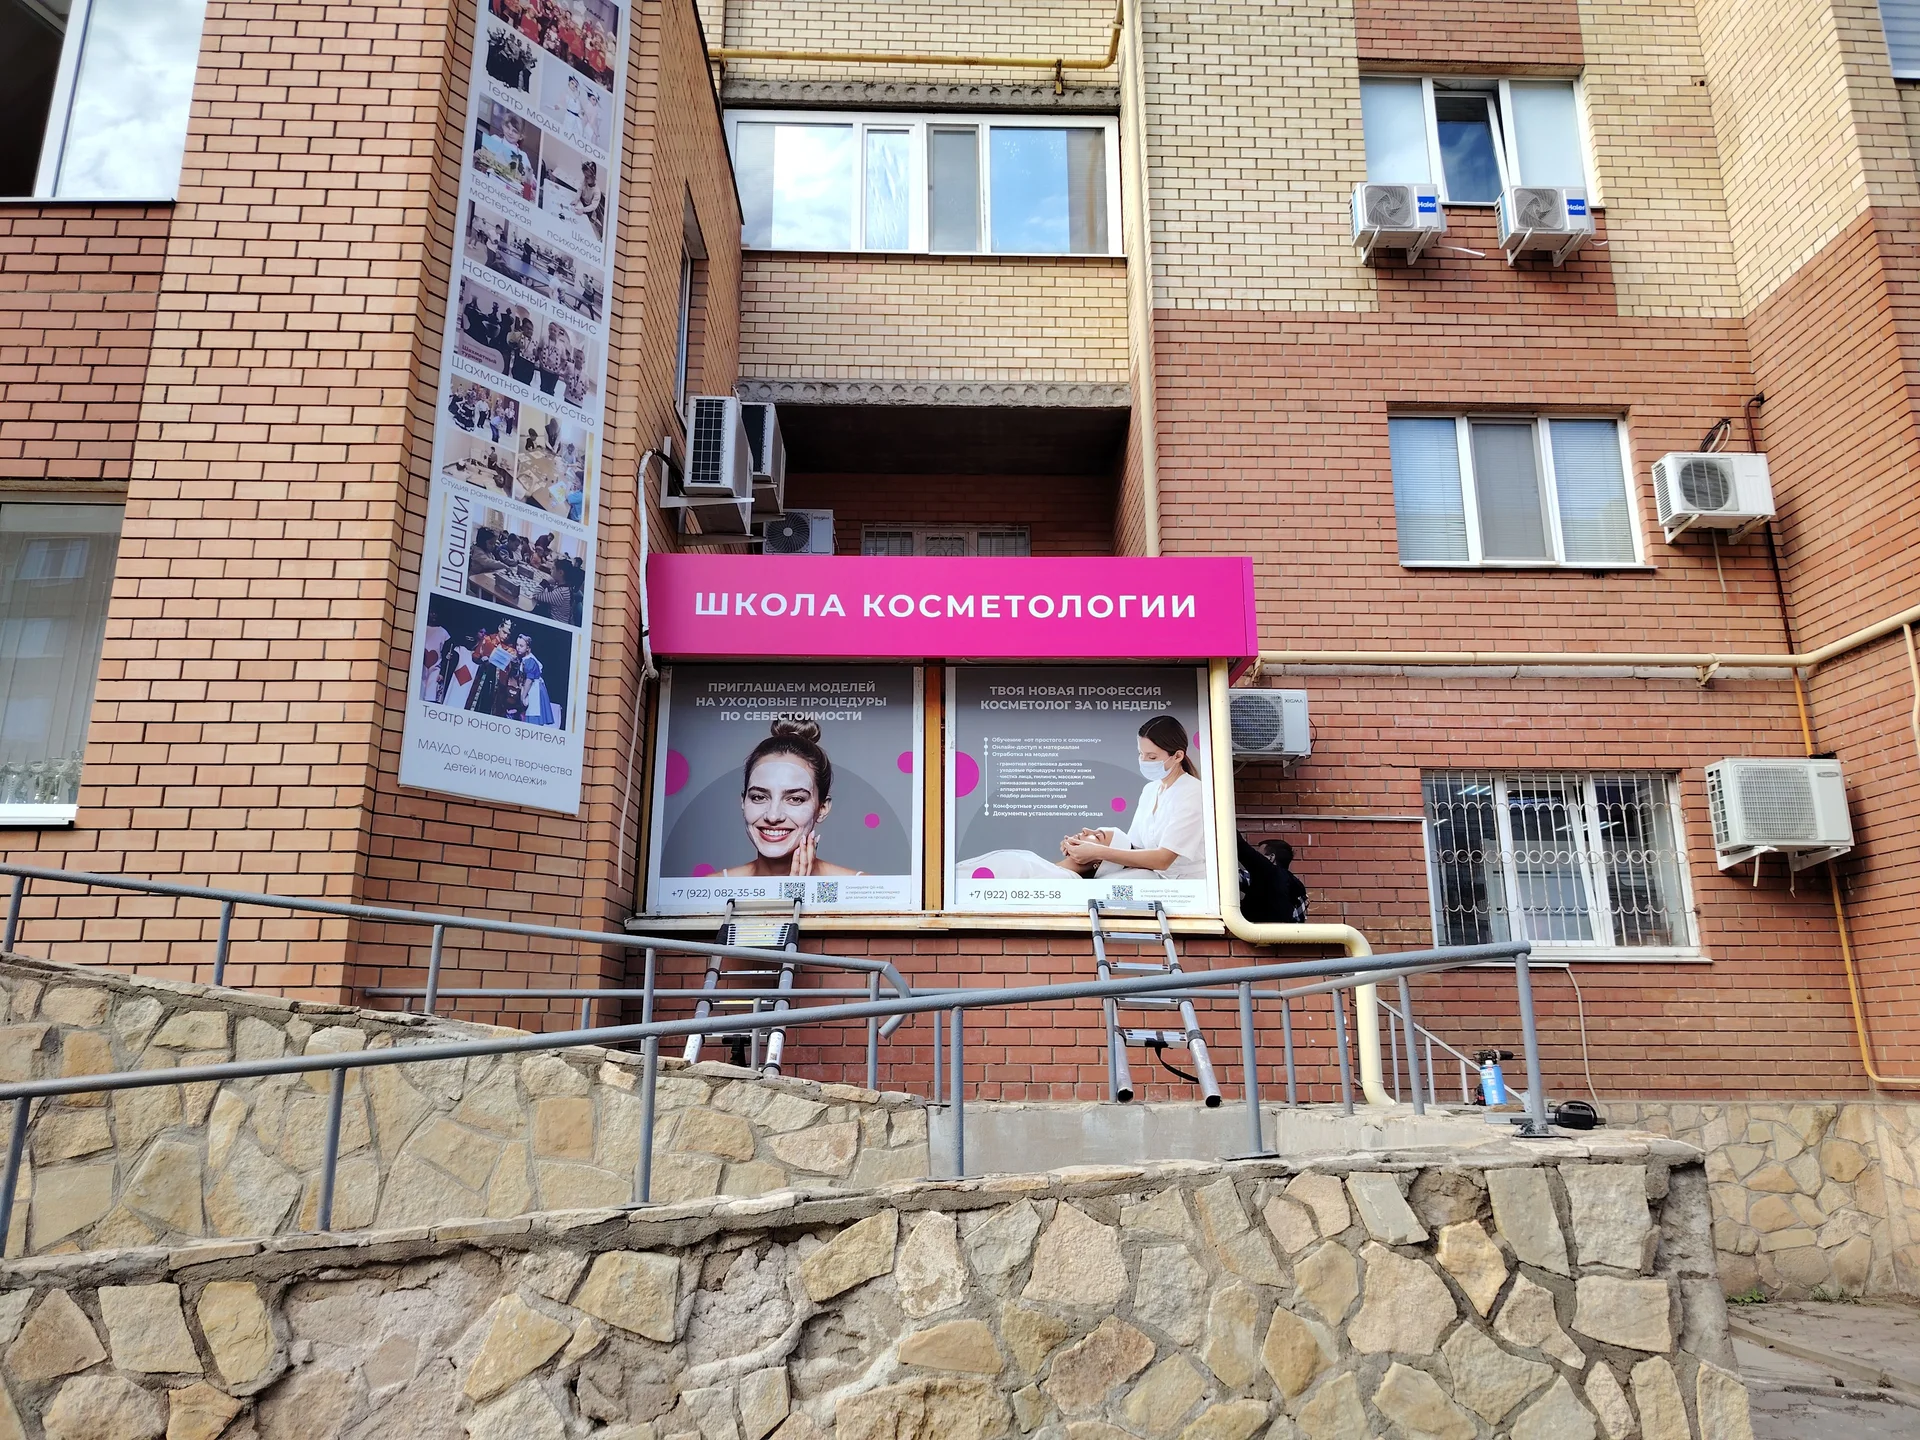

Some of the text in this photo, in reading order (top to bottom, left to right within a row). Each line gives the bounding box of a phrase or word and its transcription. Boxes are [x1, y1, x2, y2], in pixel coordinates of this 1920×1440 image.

[487, 80, 606, 161] Театр моды «Лора»
[469, 187, 532, 226] мастерская
[470, 173, 531, 214] Творческая
[1417, 201, 1436, 209] Haier
[546, 229, 601, 264] психологии
[571, 230, 601, 254] Школа
[462, 258, 597, 335] Настольный теннис
[461, 344, 497, 365] Шахматный
[451, 355, 595, 427] Шахматное искусство
[440, 477, 469, 493] Студия
[470, 488, 503, 505] раннего
[504, 498, 539, 517] развития
[440, 495, 470, 594] Шашки
[695, 591, 1196, 619] ШКОЛА КОСМЕТОЛОГИИ
[708, 680, 876, 694] ПРИГЛАШАЕМ МОДЕЛЕЙ
[990, 686, 1162, 697] ТВОЯ НОВАЯ ПРОФЕССИЯ
[695, 697, 887, 708] НА УХОДОВЫЕ ПРОЦЕДУРЫ
[720, 711, 863, 721] ПО СЕБЕСТОИМОСТИ
[980, 700, 1072, 711] КОСМЕТОЛОГ
[1074, 700, 1093, 711] ЗА
[1095, 700, 1109, 711] 10
[422, 704, 566, 746] Театр юного зрителя
[417, 738, 573, 777] МАУДО «Дворец творчества
[443, 761, 548, 787] детей и молодежи»
[671, 887, 766, 899] +7 (922) 082-35-58
[969, 889, 1062, 901] +7 (922) 082-35-58
